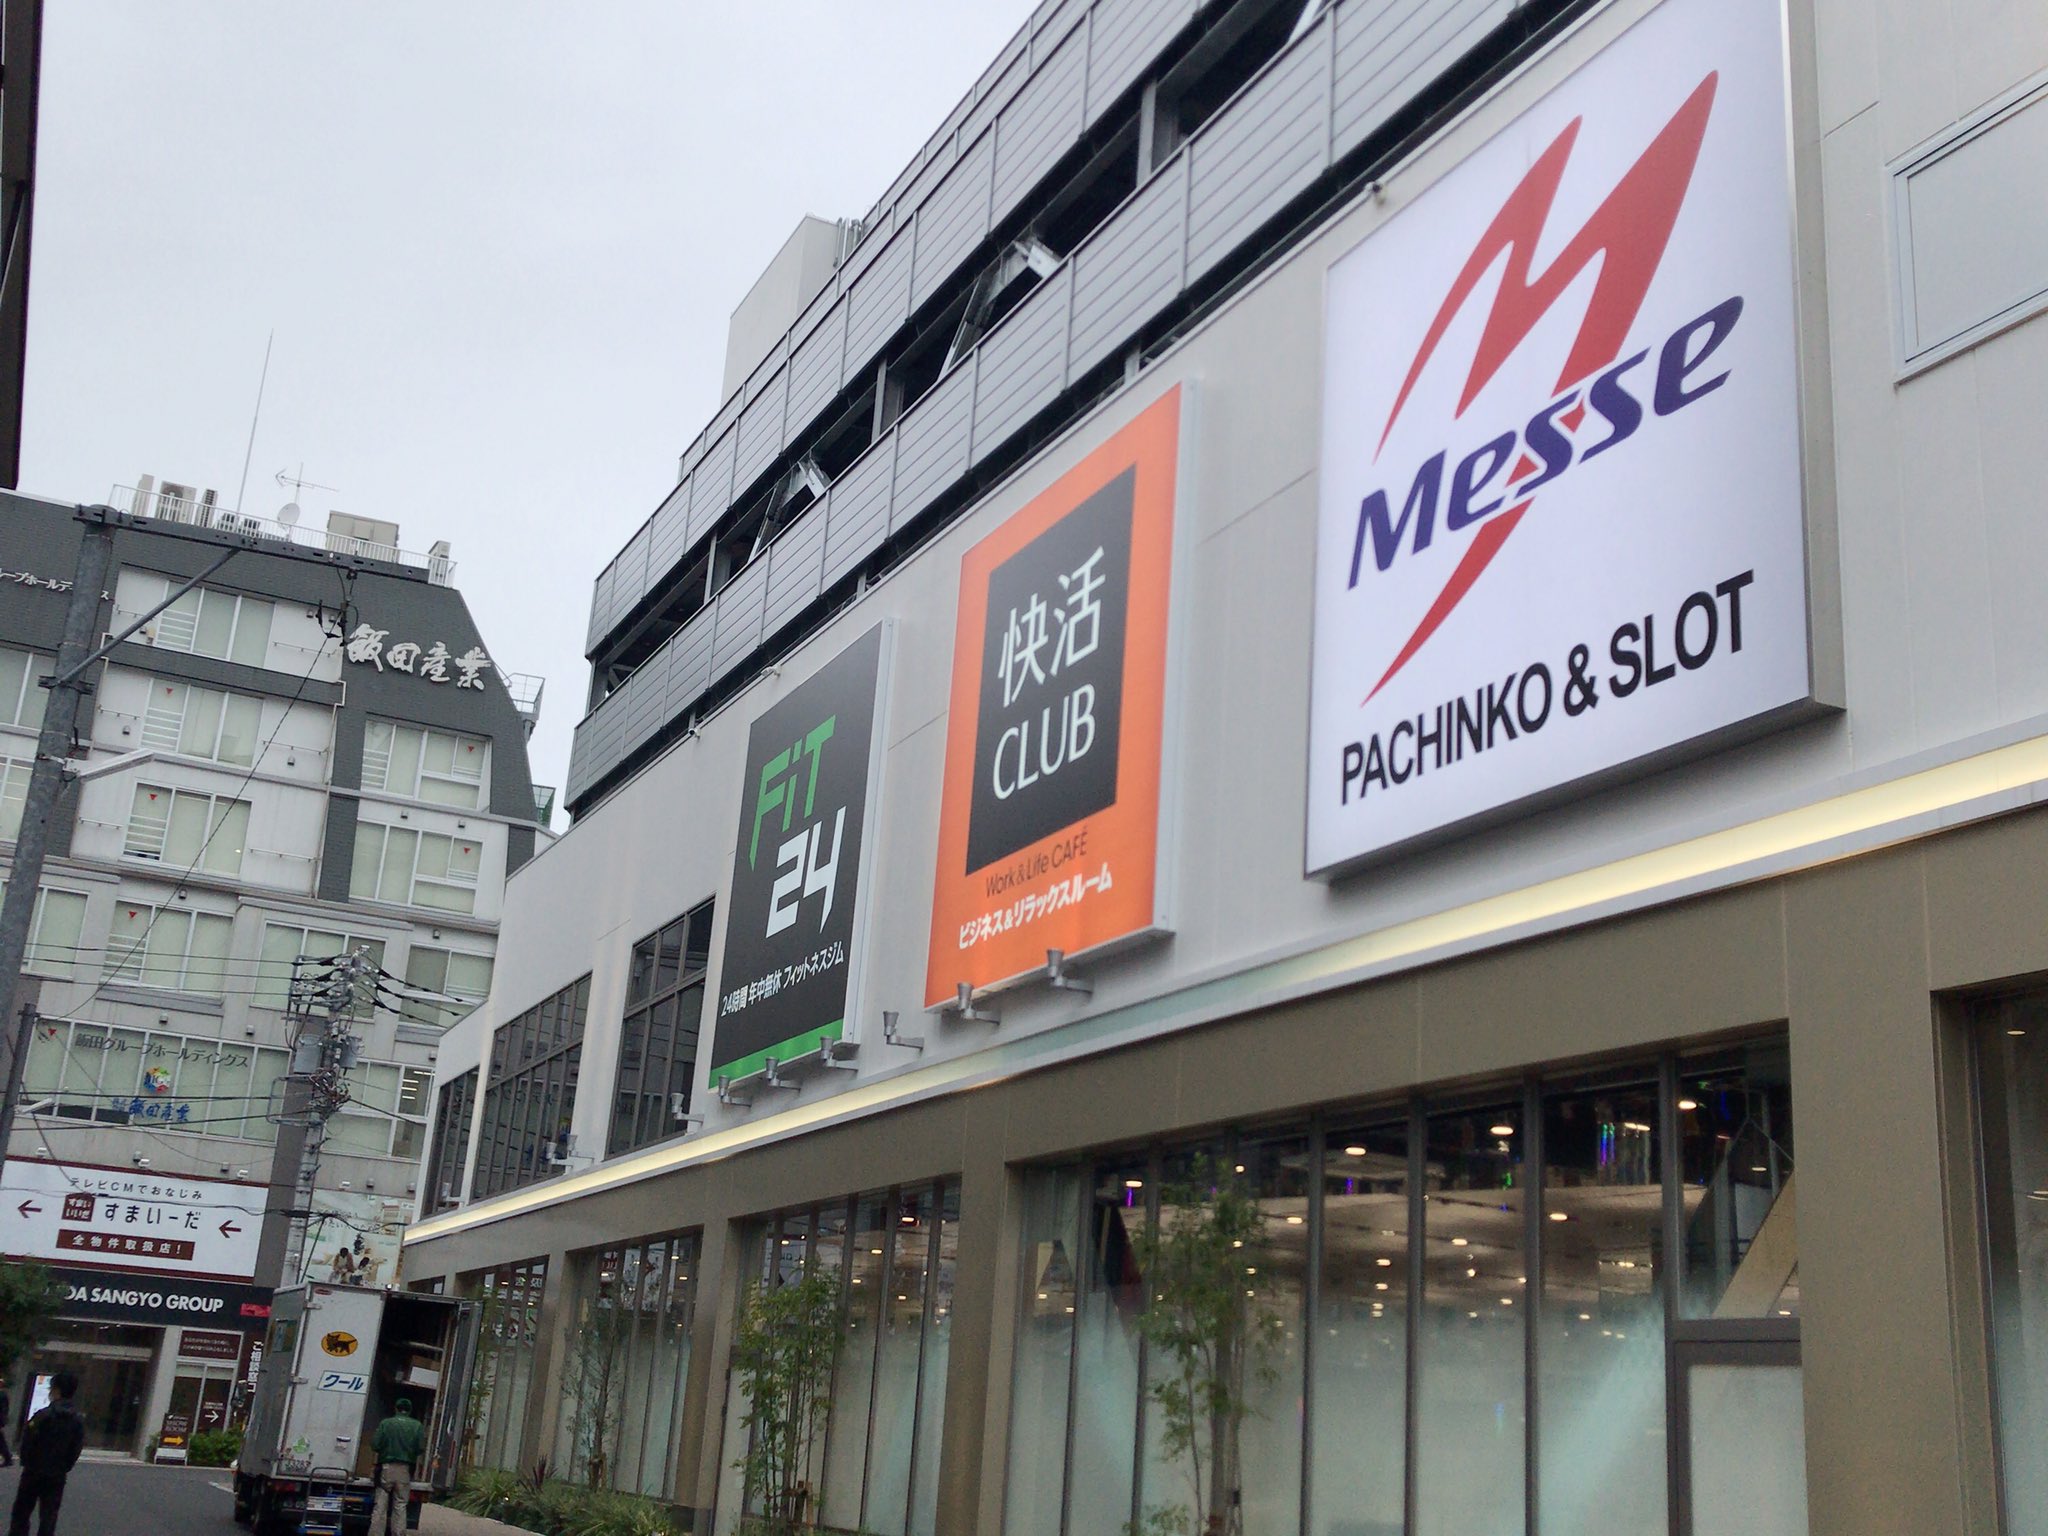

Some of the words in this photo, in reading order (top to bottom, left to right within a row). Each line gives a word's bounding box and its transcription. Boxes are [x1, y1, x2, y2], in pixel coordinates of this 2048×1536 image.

[1348, 296, 1744, 591] Messe
[347, 623, 492, 691] 飯田産業
[997, 546, 1106, 708] 快活
[1342, 661, 1554, 806] PACHINKO
[1563, 642, 1600, 719] &
[1609, 569, 1754, 699] SLOT
[992, 683, 1096, 800] CLUB
[765, 805, 847, 939] 24
[986, 867, 1015, 898] Work
[1016, 864, 1025, 886] &
[1027, 852, 1049, 880] Life
[1051, 826, 1088, 868] CAFÉ
[959, 862, 1113, 949] ビジネス&リラックスルーム
[721, 985, 749, 1017] 24時間
[748, 969, 782, 1005] 年中無休
[783, 941, 844, 989] フィットネスジム
[74, 1032, 248, 1068] 飯田グループホールディングス
[70, 1177, 202, 1200] テレビCMでおなじみ
[105, 1203, 201, 1229] すまいーだ
[90, 1287, 163, 1307] SANGYO
[165, 1295, 224, 1313] GROUP
[323, 1374, 364, 1391] クール
